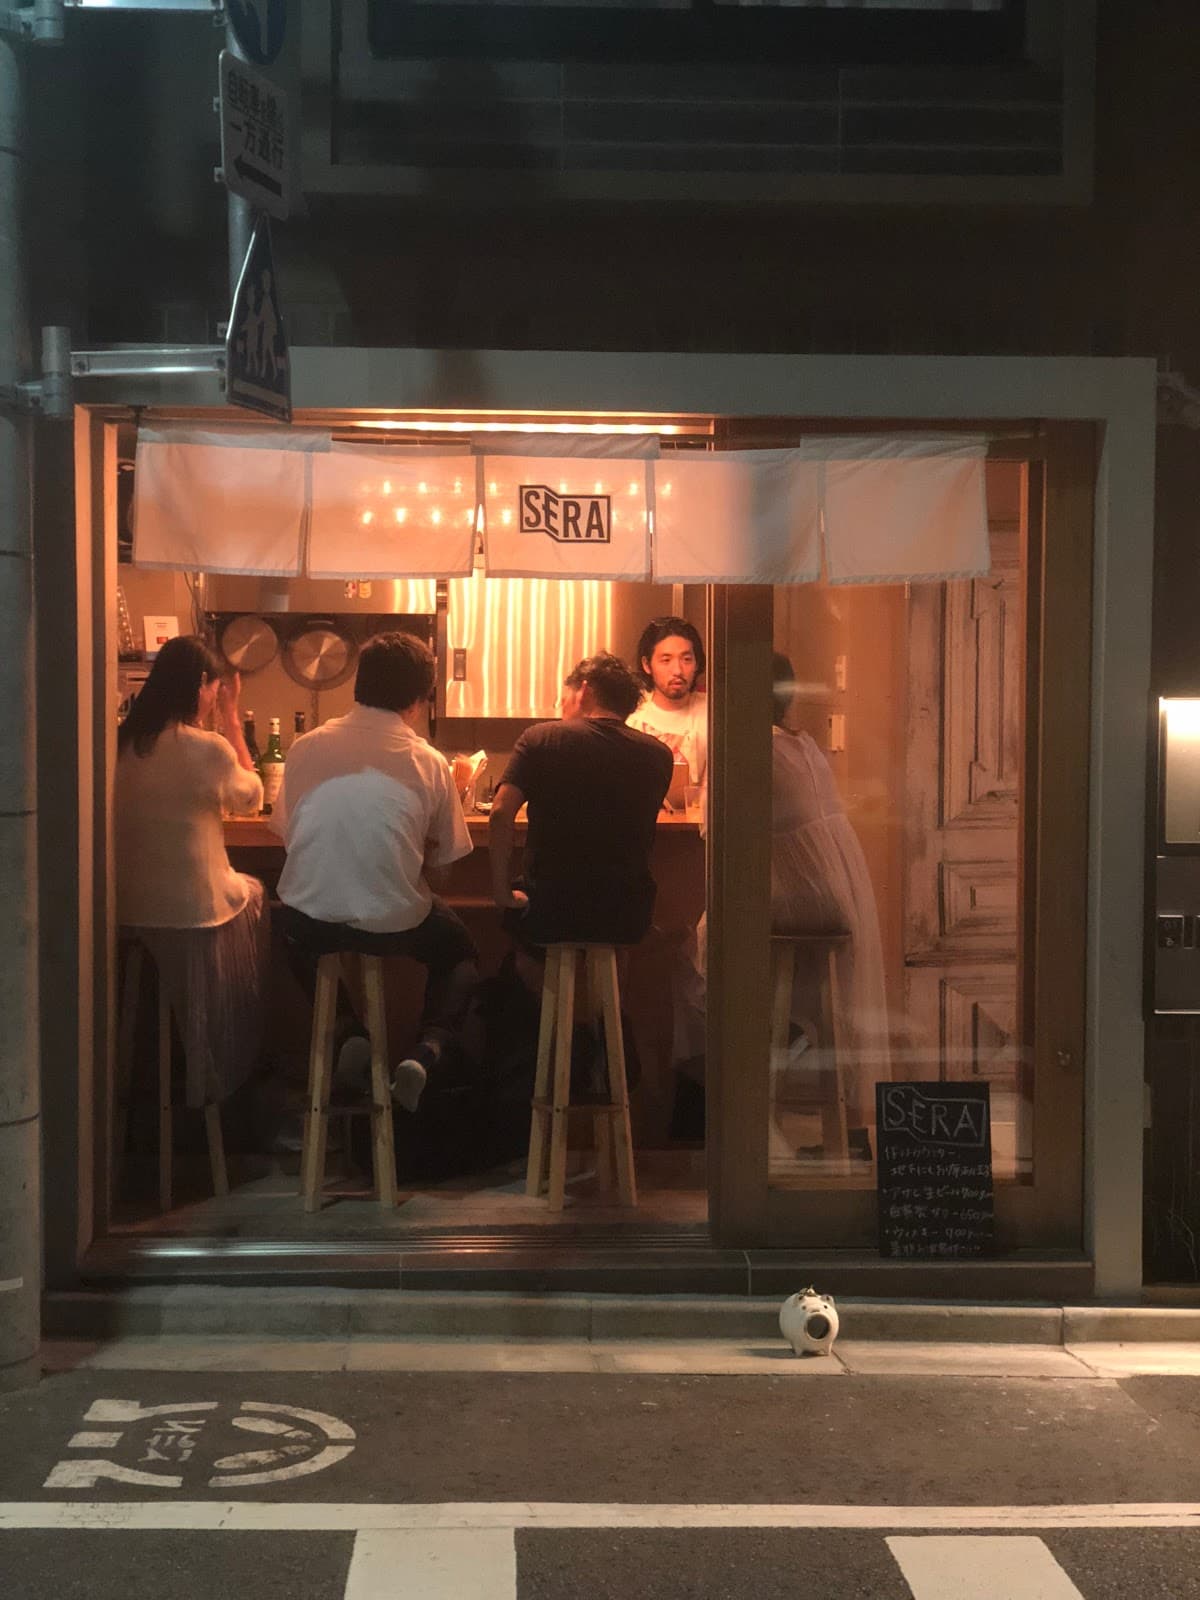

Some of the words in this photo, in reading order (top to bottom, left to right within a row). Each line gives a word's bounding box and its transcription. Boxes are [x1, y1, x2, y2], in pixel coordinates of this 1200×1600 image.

[229, 118, 284, 170] 一方通行
[524, 490, 605, 538] SERA
[887, 1089, 979, 1137] SERA
